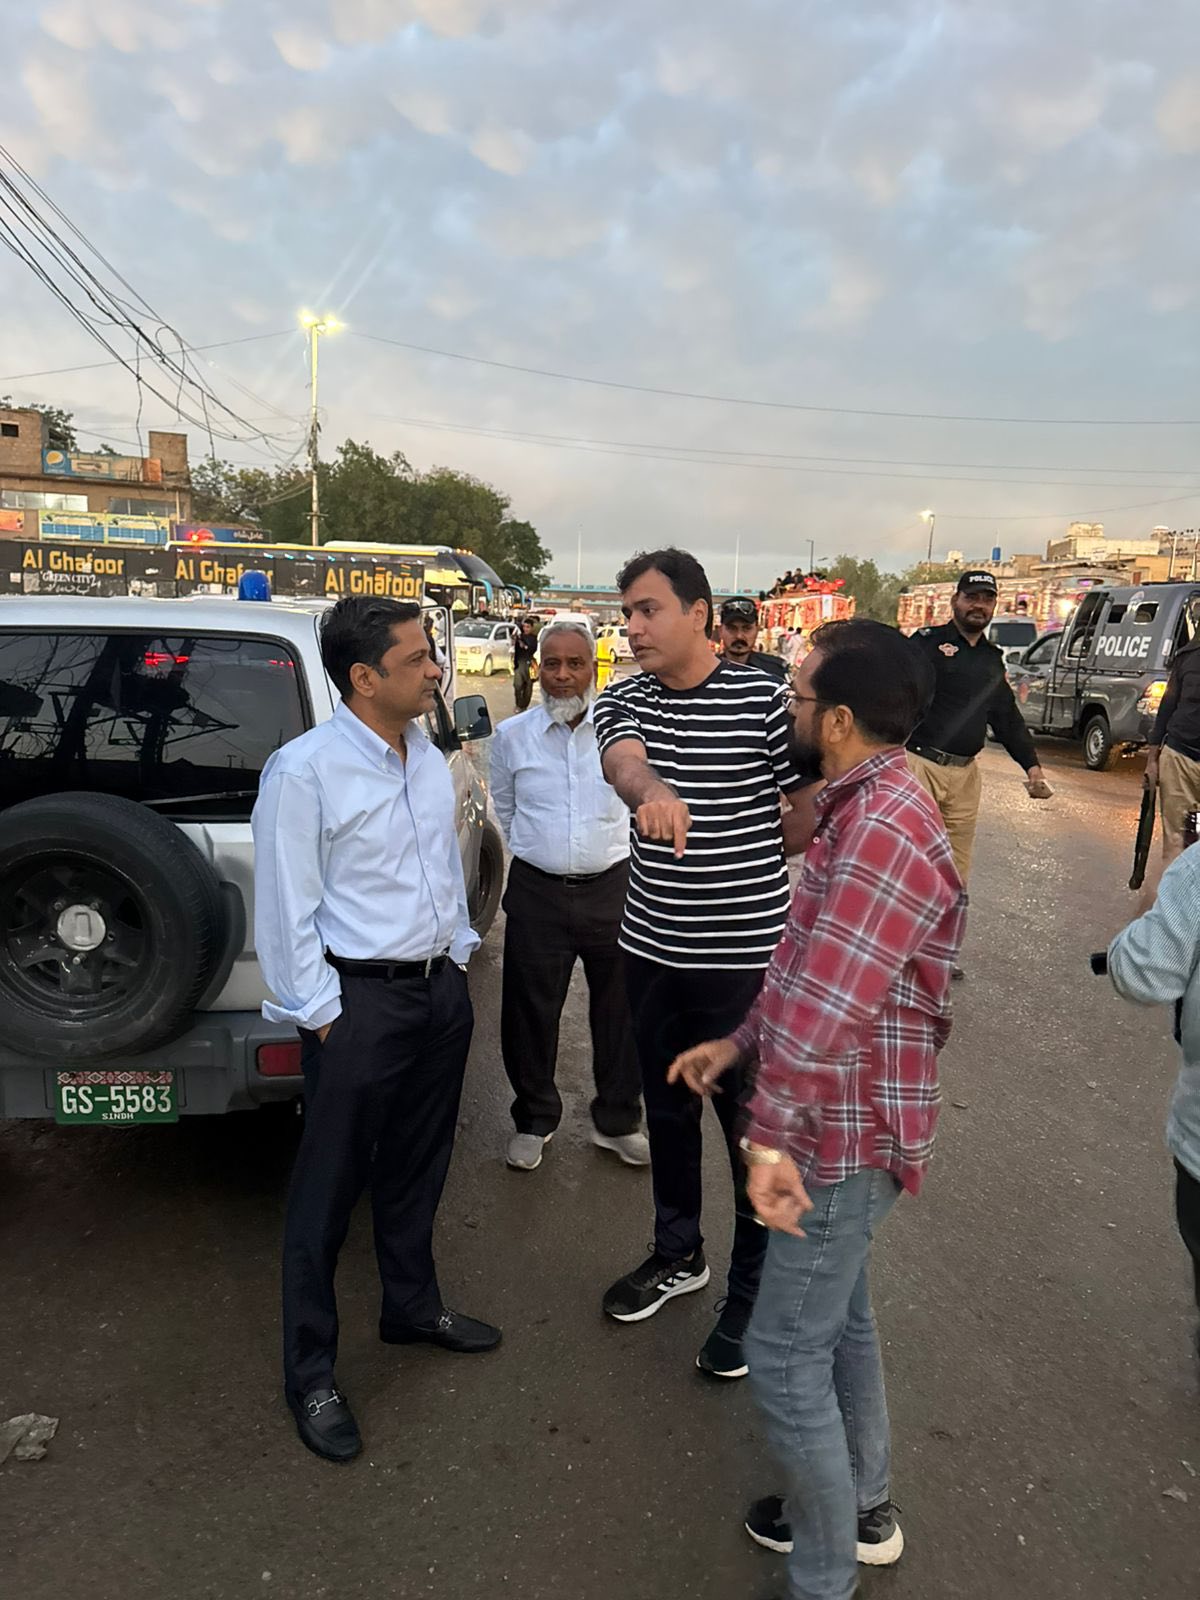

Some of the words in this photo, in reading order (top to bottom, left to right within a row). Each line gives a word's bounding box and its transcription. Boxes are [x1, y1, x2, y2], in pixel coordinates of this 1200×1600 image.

[22, 548, 43, 569] Al
[49, 550, 124, 575] Ghafoor
[175, 559, 195, 581] Al
[200, 560, 274, 585] Ghafr
[325, 567, 345, 592] Al
[350, 569, 423, 598] Ghafoor
[1095, 635, 1152, 658] POLICE
[61, 1085, 172, 1114] GS-5583
[101, 1112, 134, 1120] SINDH
